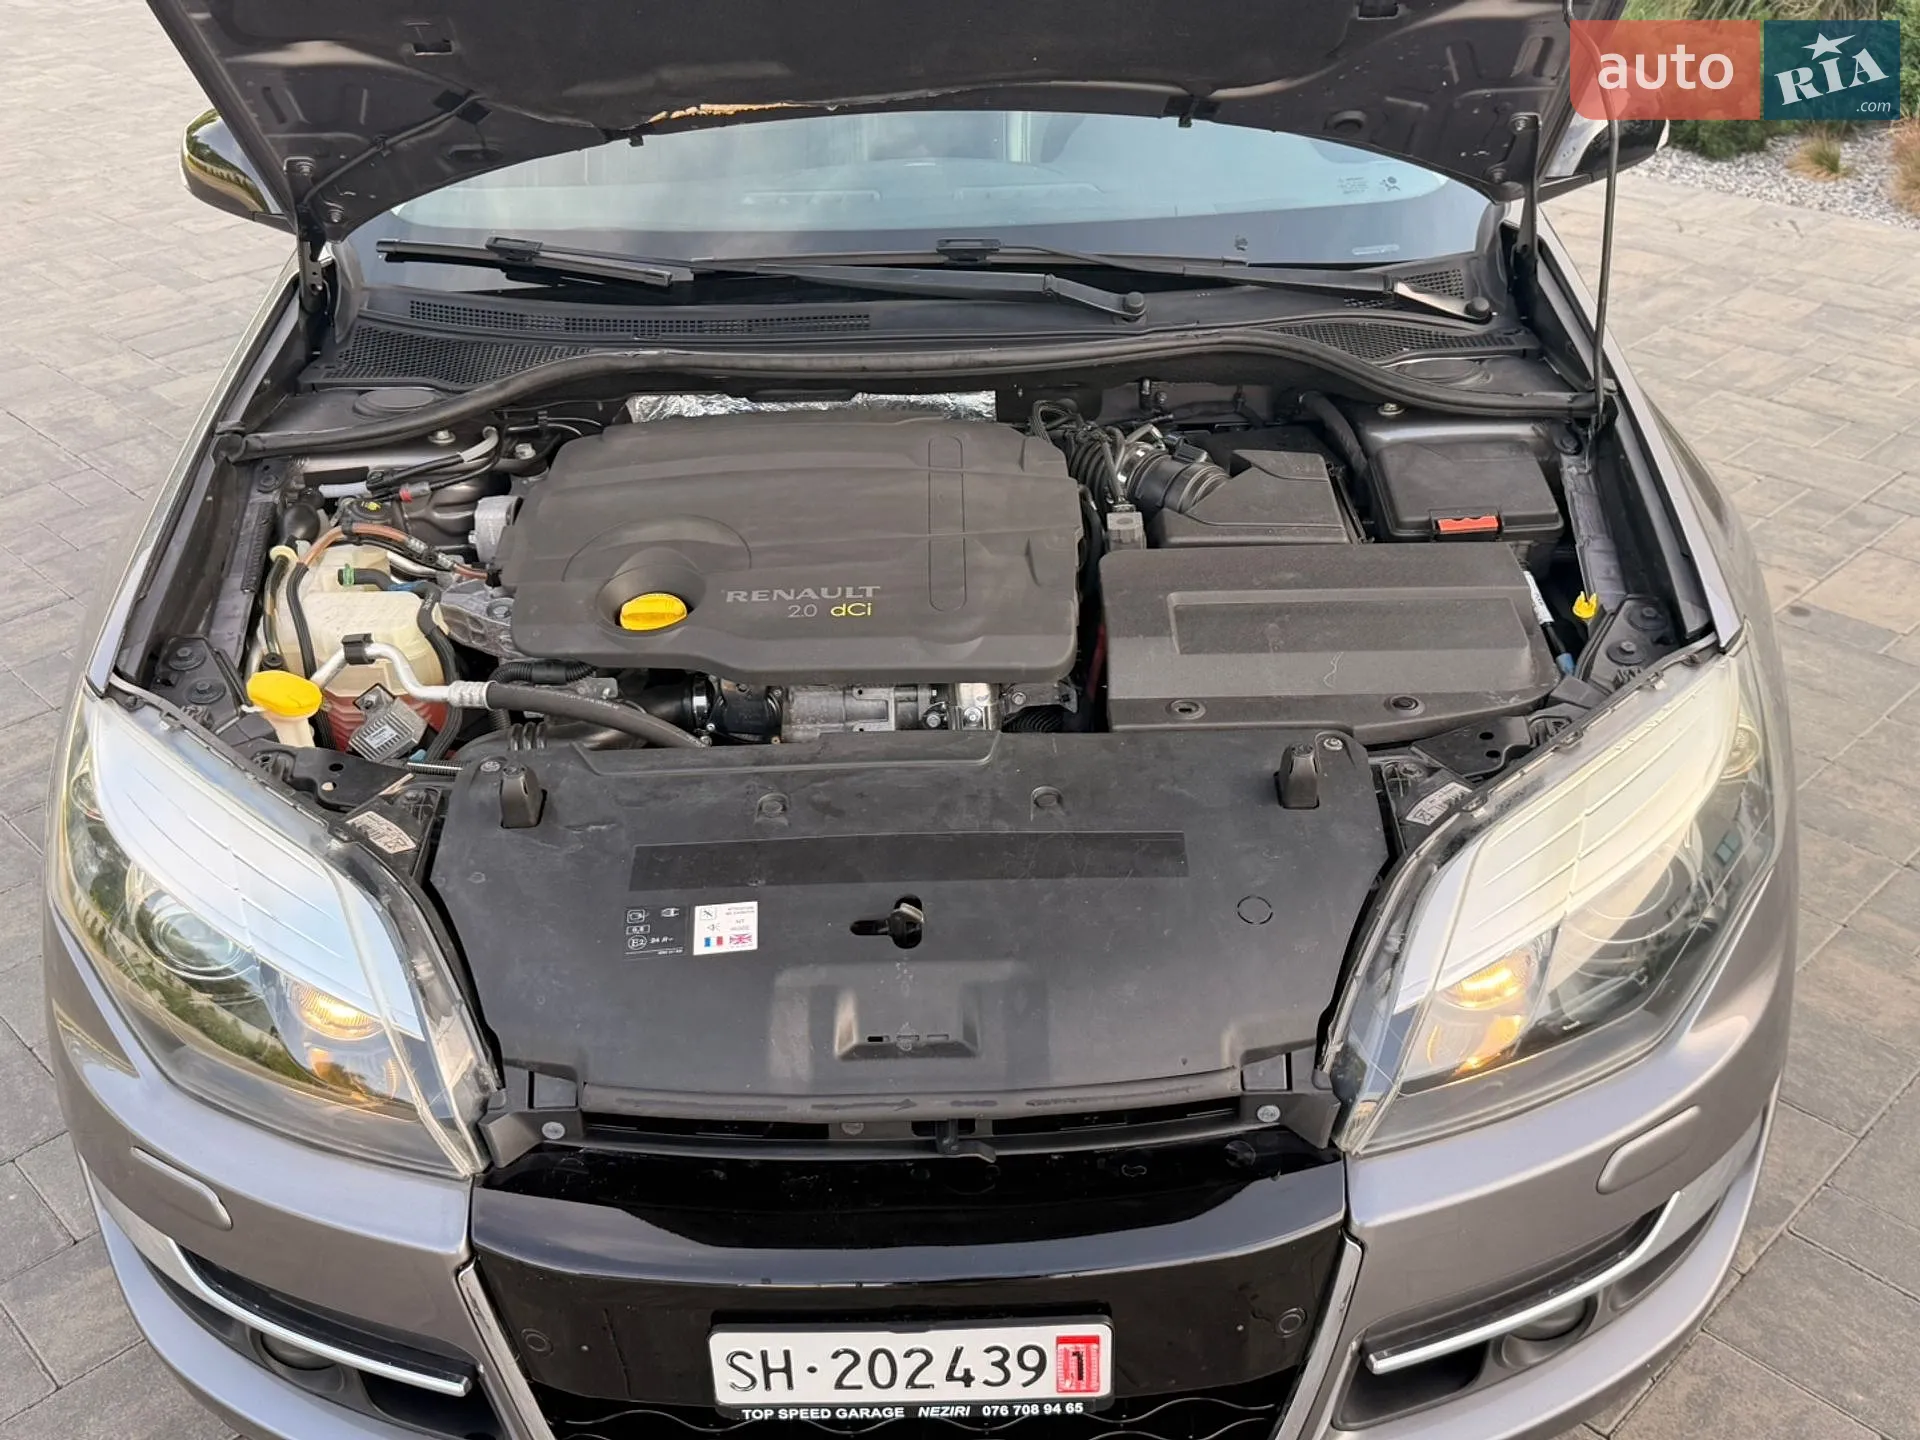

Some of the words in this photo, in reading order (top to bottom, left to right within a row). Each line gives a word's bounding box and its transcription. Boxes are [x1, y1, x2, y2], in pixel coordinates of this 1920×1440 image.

[726, 586, 881, 602] RENAULT
[830, 602, 873, 617] dCi
[741, 1408, 774, 1420] TOP
[778, 1408, 831, 1419] SPEED
[835, 1406, 905, 1419] GARAGE
[917, 1405, 971, 1417] NEZIRI
[982, 1405, 1009, 1416] 076
[1013, 1404, 1039, 1415] 708
[1043, 1403, 1061, 1415] 94
[1065, 1402, 1083, 1413] 65
